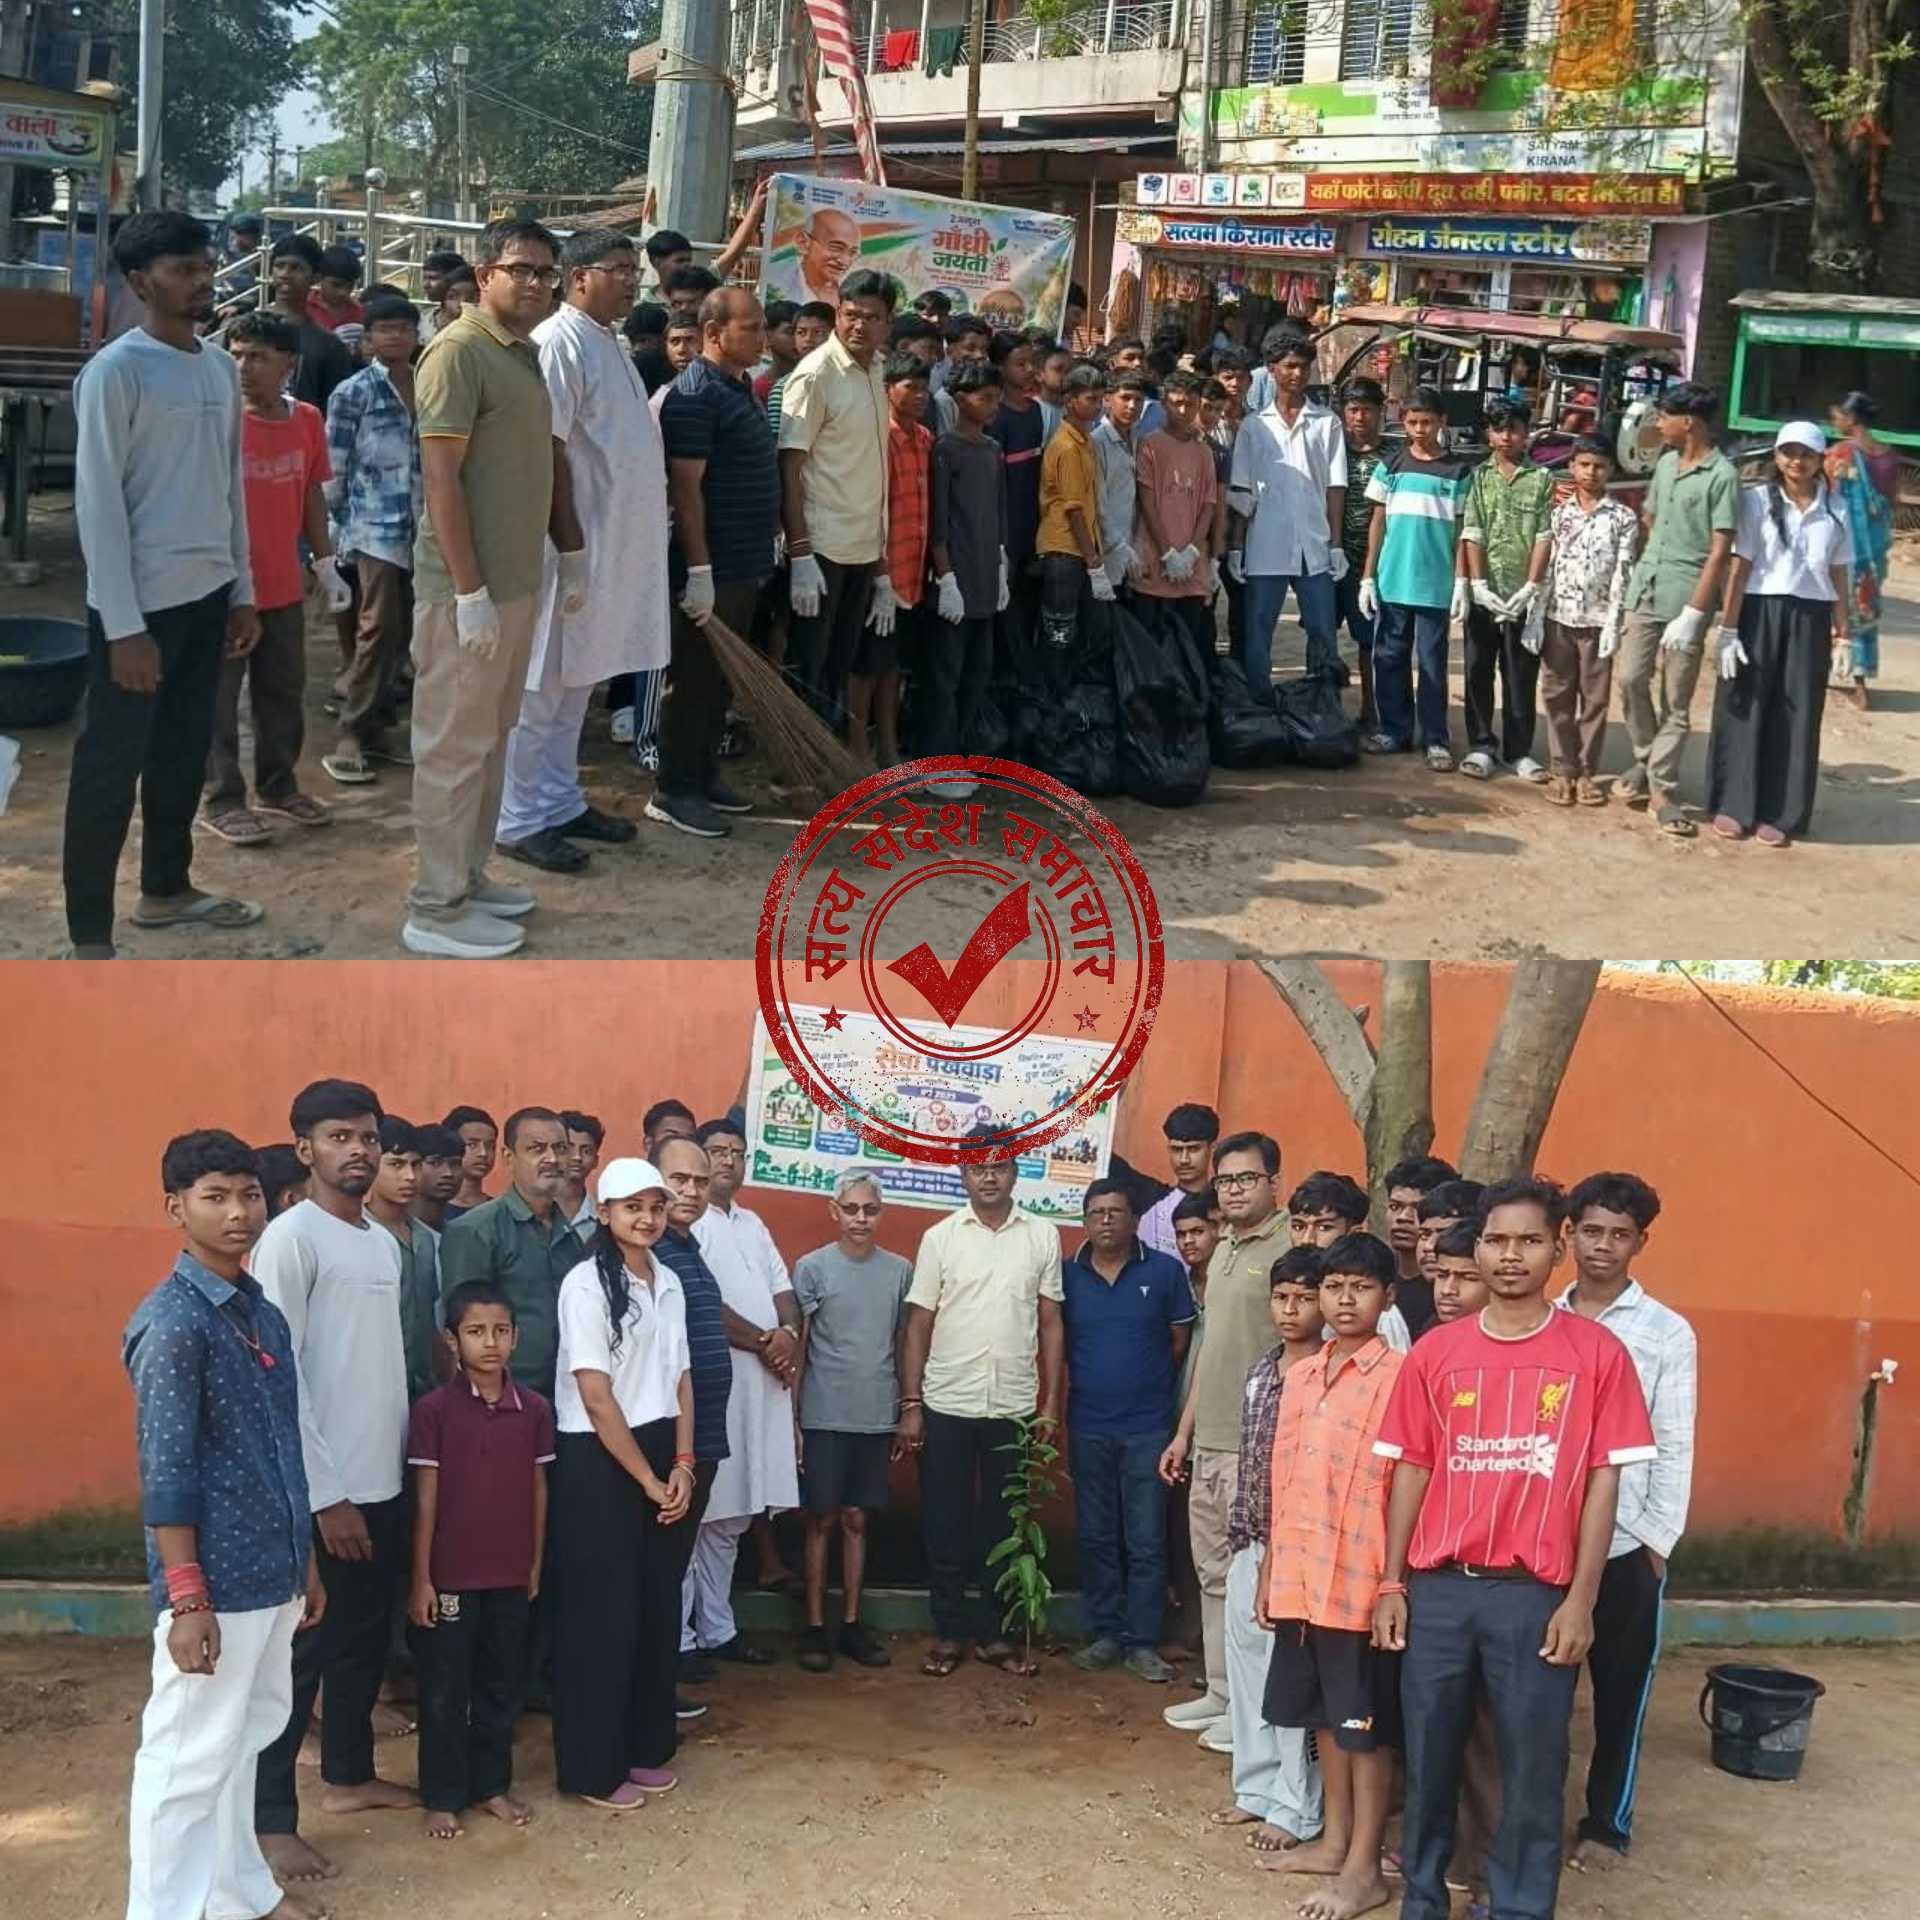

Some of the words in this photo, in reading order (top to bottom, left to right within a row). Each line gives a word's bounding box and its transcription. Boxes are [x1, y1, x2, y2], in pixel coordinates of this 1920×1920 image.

[1526, 155, 1577, 168] KIRANA
[1164, 222, 1217, 243] सत्यम
[1219, 216, 1285, 246] किराना
[1287, 219, 1335, 248] स्टोर
[1371, 222, 1426, 249] रोहन
[1509, 223, 1570, 255] स्टोर
[1456, 1434, 1531, 1453] Standard
[1449, 1455, 1530, 1473] Chartered
